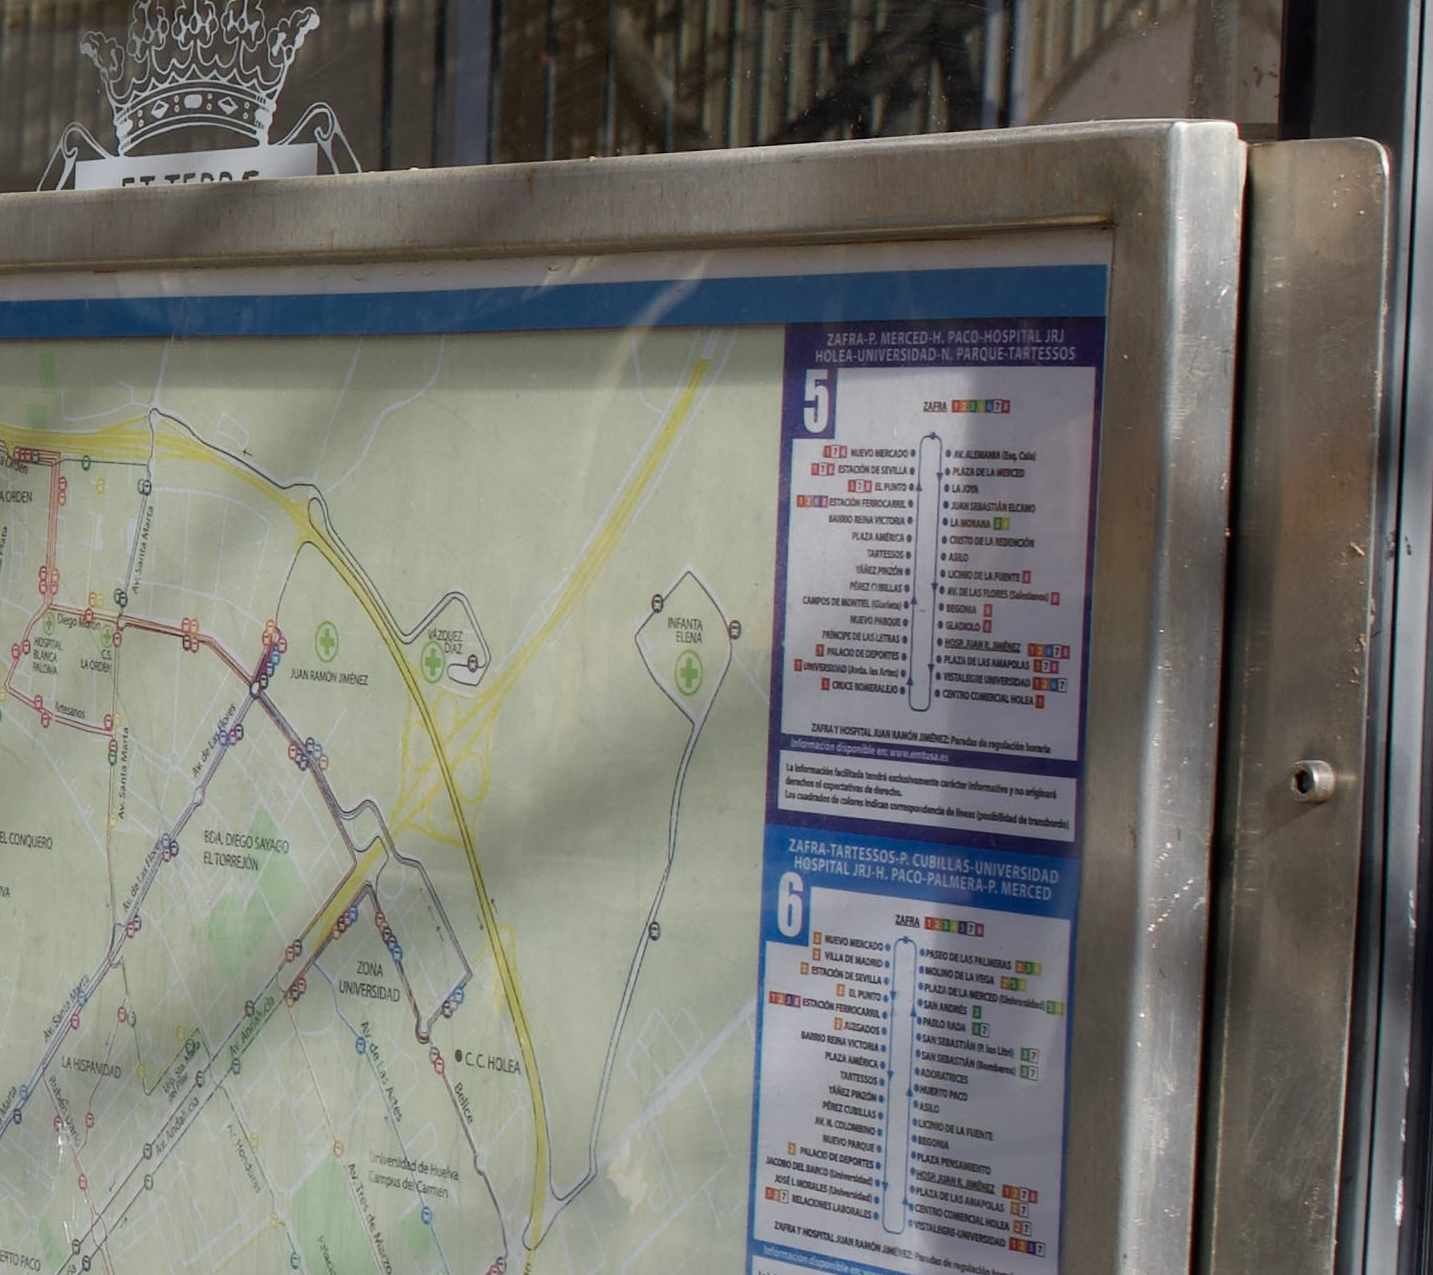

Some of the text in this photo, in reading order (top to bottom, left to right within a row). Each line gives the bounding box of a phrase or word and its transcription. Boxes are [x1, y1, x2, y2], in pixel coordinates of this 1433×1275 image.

[803, 369, 829, 433] 5
[777, 872, 803, 937] 6
[1000, 882, 1052, 901] MERCED
[356, 960, 384, 977] ZONA
